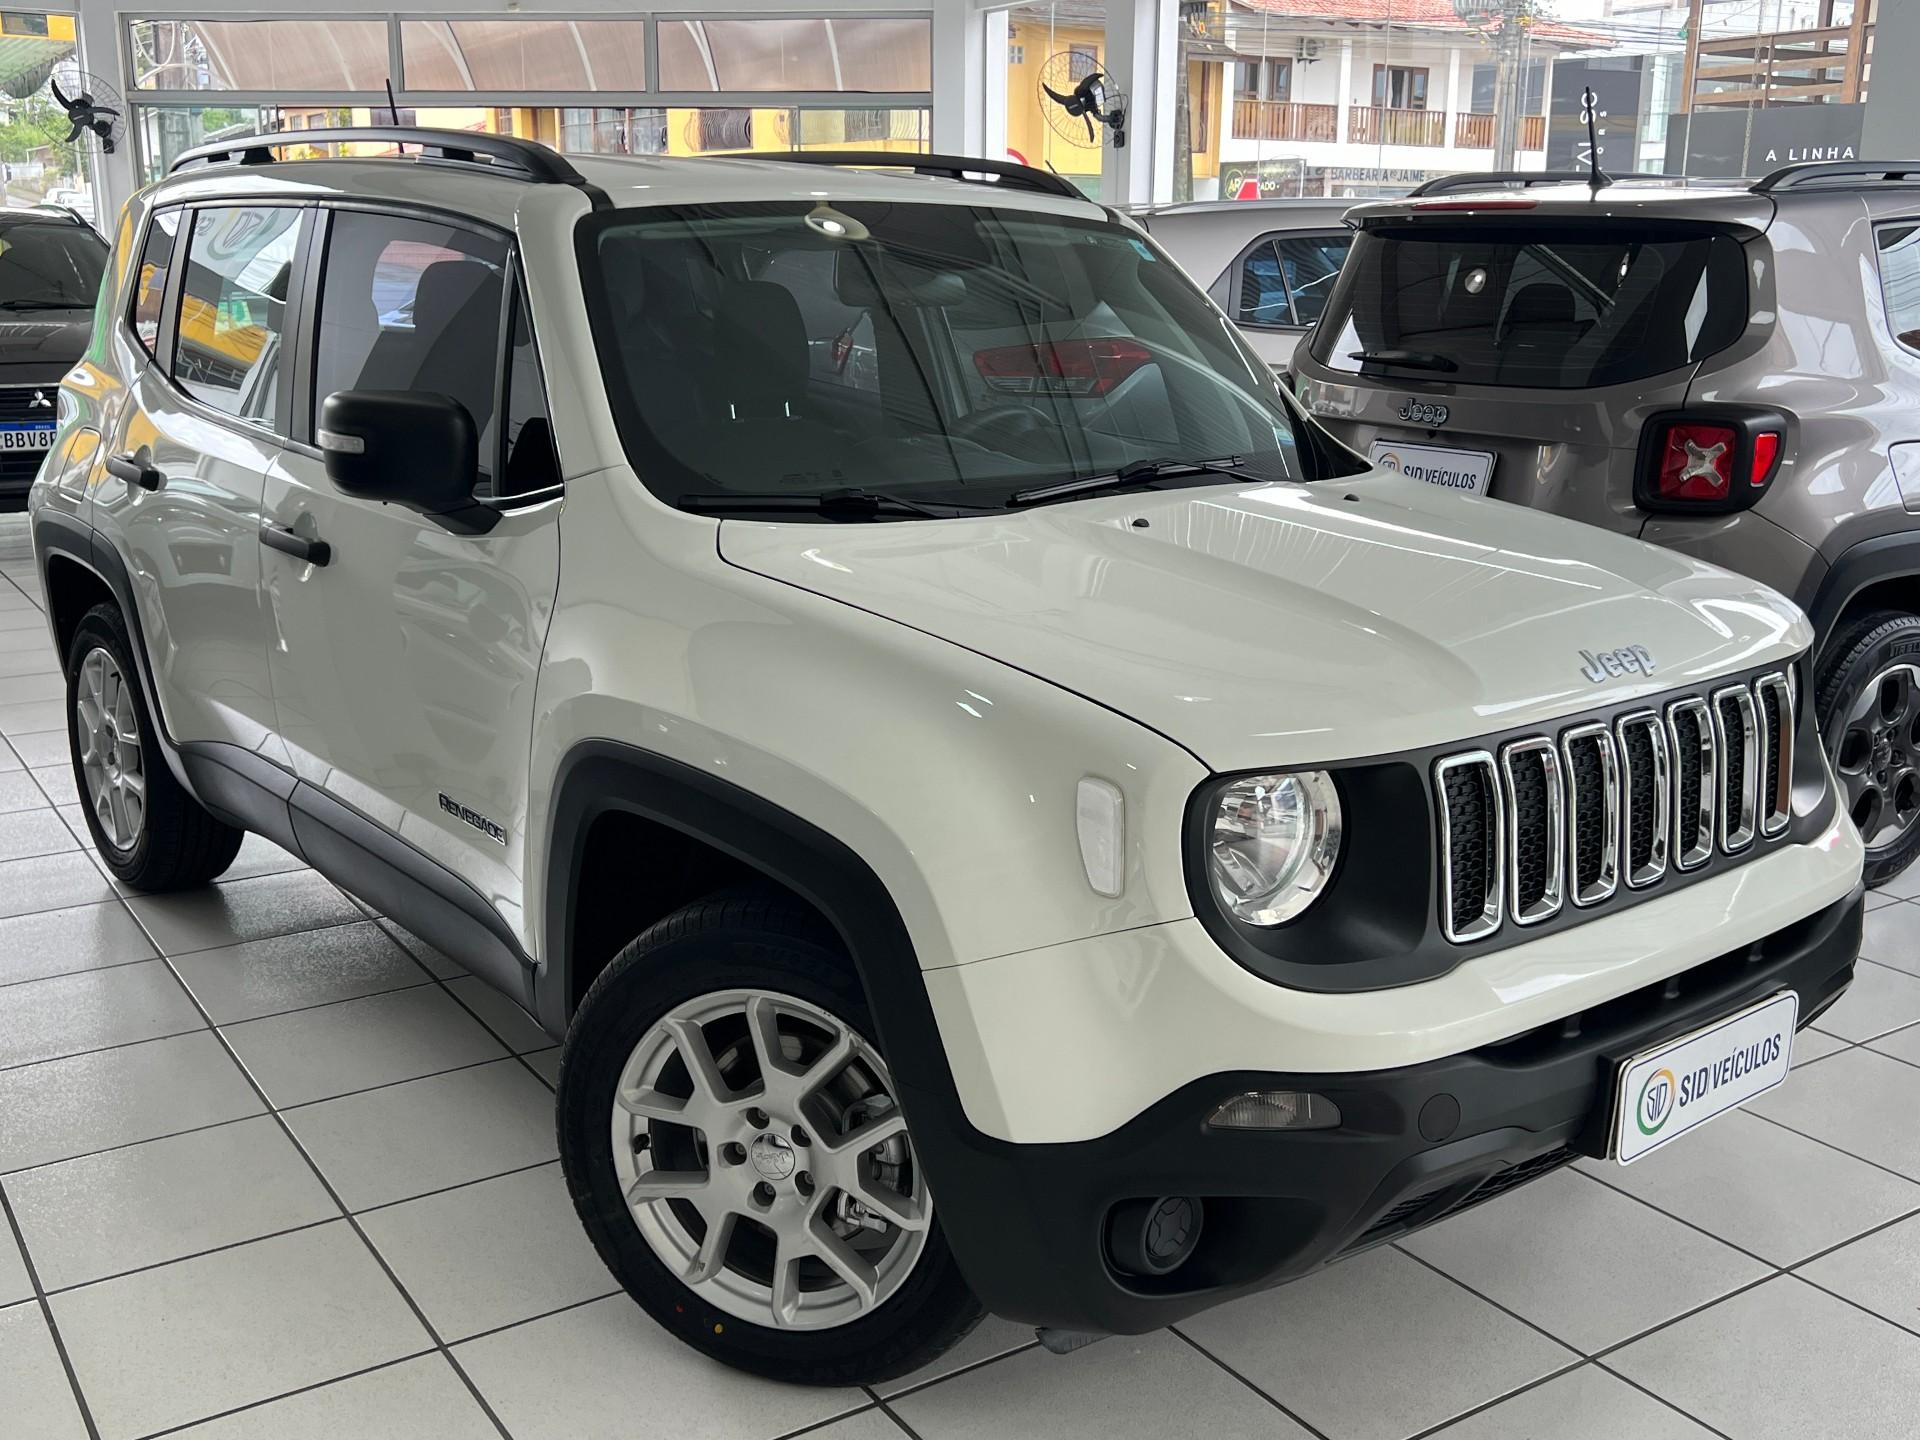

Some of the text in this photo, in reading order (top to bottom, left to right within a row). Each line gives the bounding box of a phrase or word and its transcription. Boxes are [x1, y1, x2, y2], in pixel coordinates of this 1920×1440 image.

[1765, 146, 1855, 161] A LINHA
[1398, 169, 1425, 182] JAIME
[1398, 397, 1450, 428] Jeep
[1425, 466, 1477, 490] VEÍCULOS
[1578, 644, 1656, 684] Jeep
[438, 792, 505, 844] RENEGADE
[1679, 1033, 1781, 1108] SID VEÍCULOS
